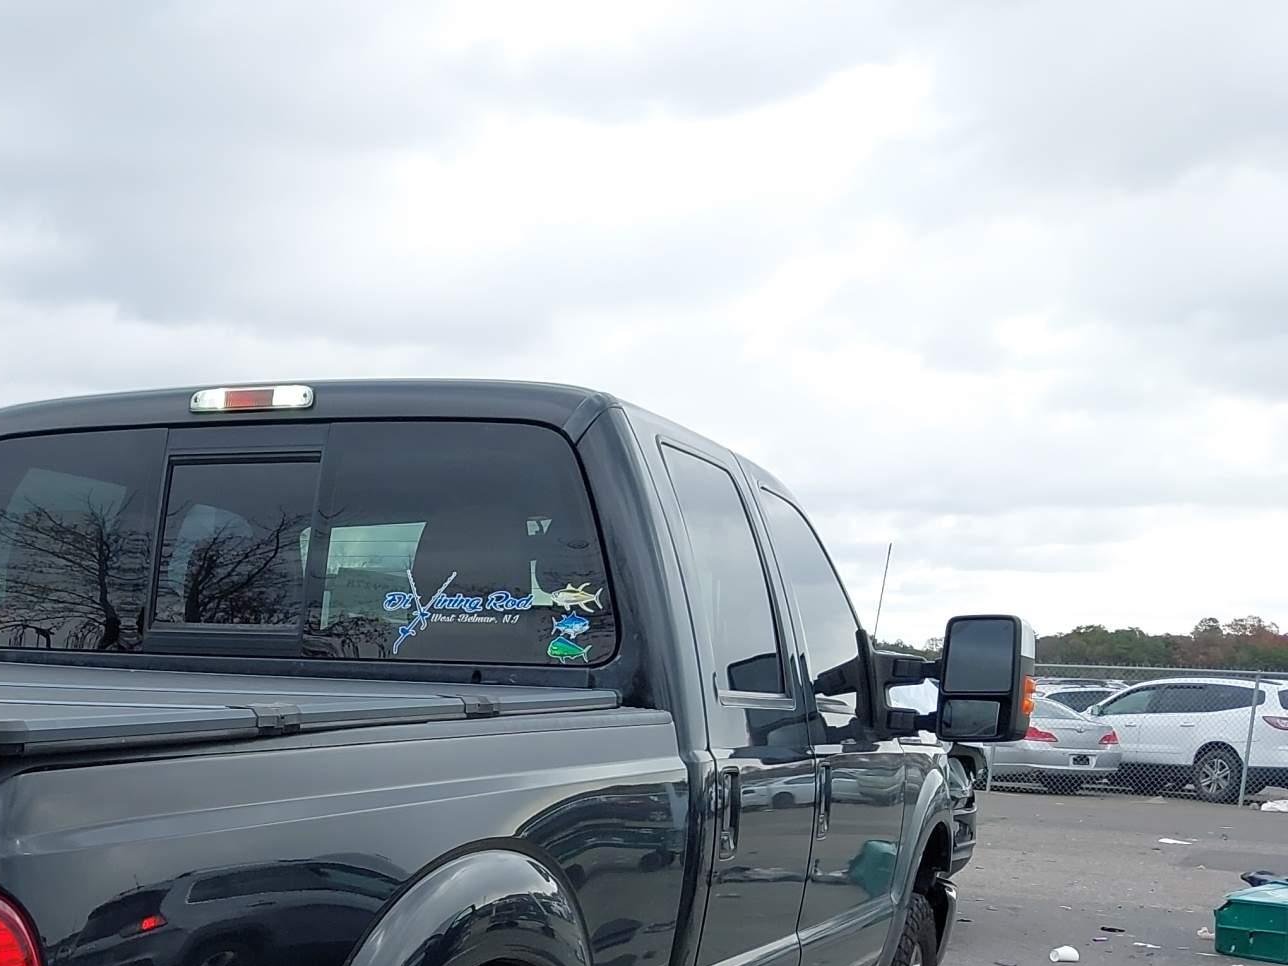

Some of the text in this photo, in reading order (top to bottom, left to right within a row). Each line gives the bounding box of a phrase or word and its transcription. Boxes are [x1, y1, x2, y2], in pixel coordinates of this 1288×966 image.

[485, 590, 535, 612] Rod
[430, 613, 456, 623] West
[457, 613, 498, 624] Belmar,
